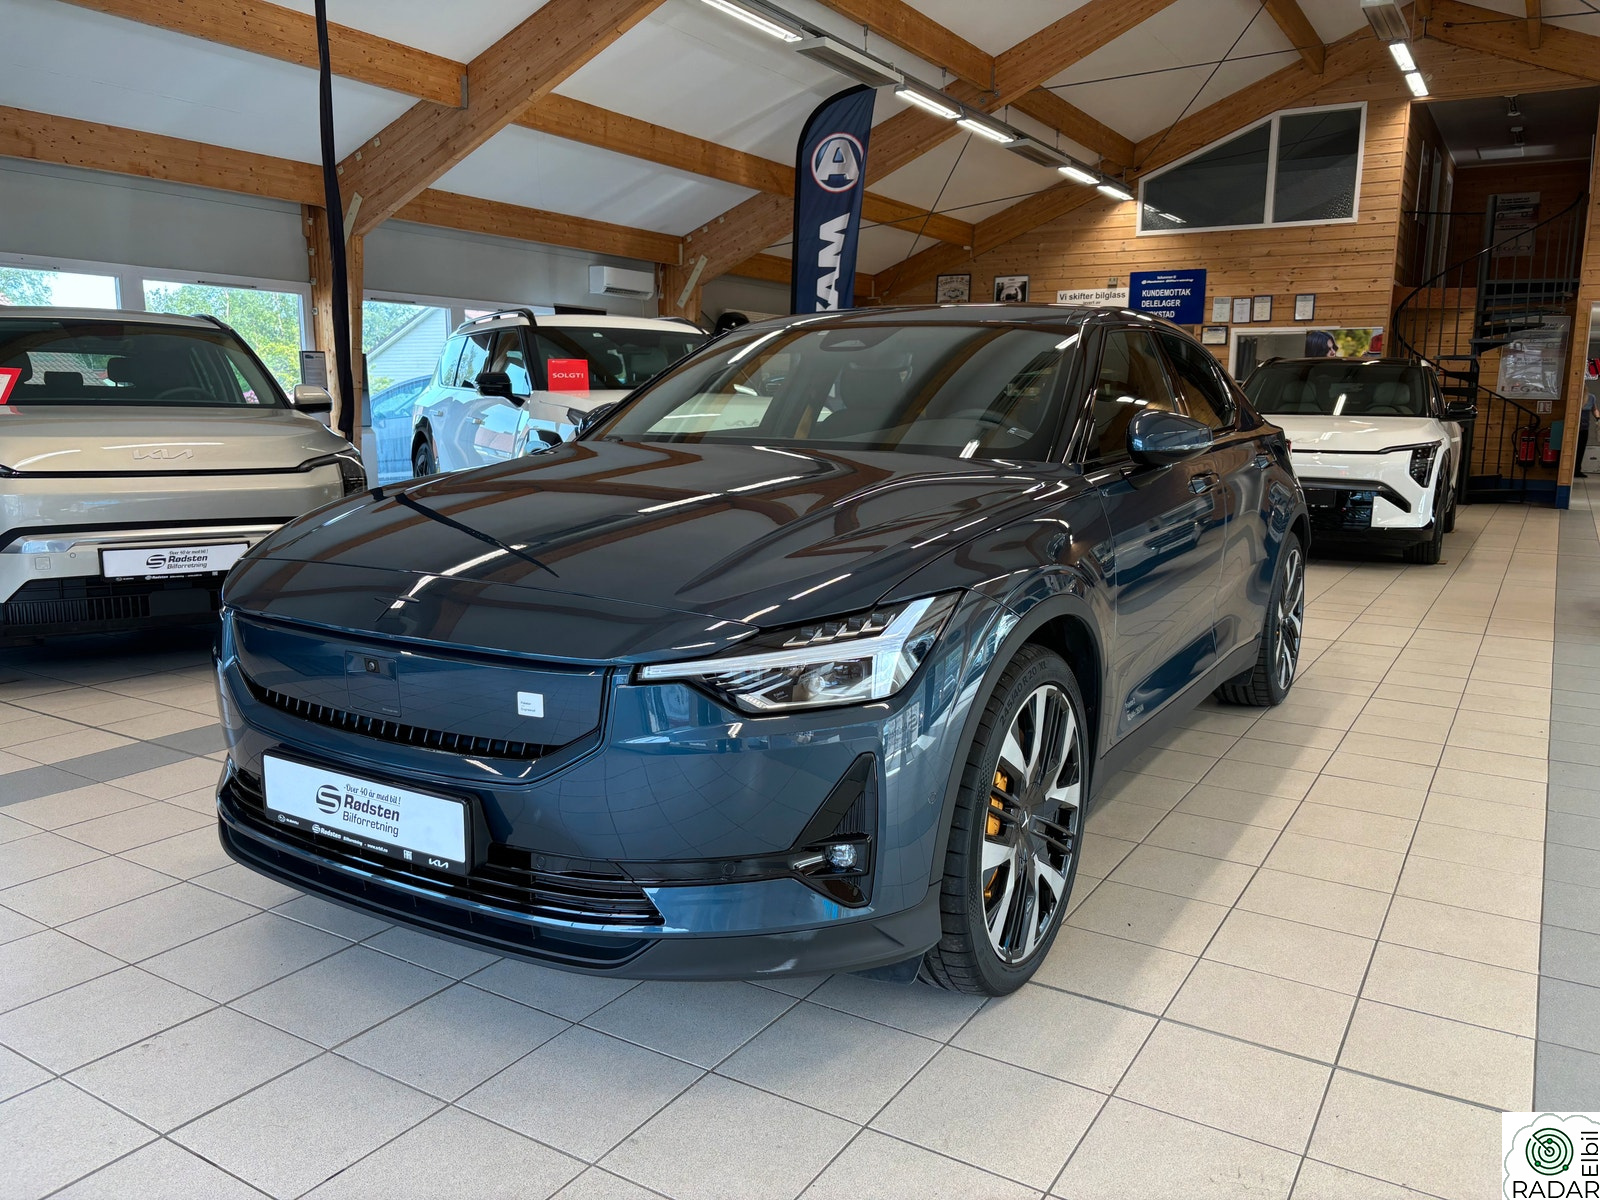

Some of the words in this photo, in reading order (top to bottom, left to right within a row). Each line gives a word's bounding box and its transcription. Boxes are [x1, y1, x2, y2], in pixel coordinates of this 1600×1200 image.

[1069, 292, 1094, 300] skifter
[1095, 291, 1126, 300] bilglass
[1141, 288, 1191, 297] KUNDEMOTTAK
[1141, 299, 1181, 308] DELELAGER
[360, 787, 368, 797] 40
[344, 793, 400, 821] Rødsten
[342, 811, 399, 837] Bilforretning
[428, 857, 449, 869] KIA
